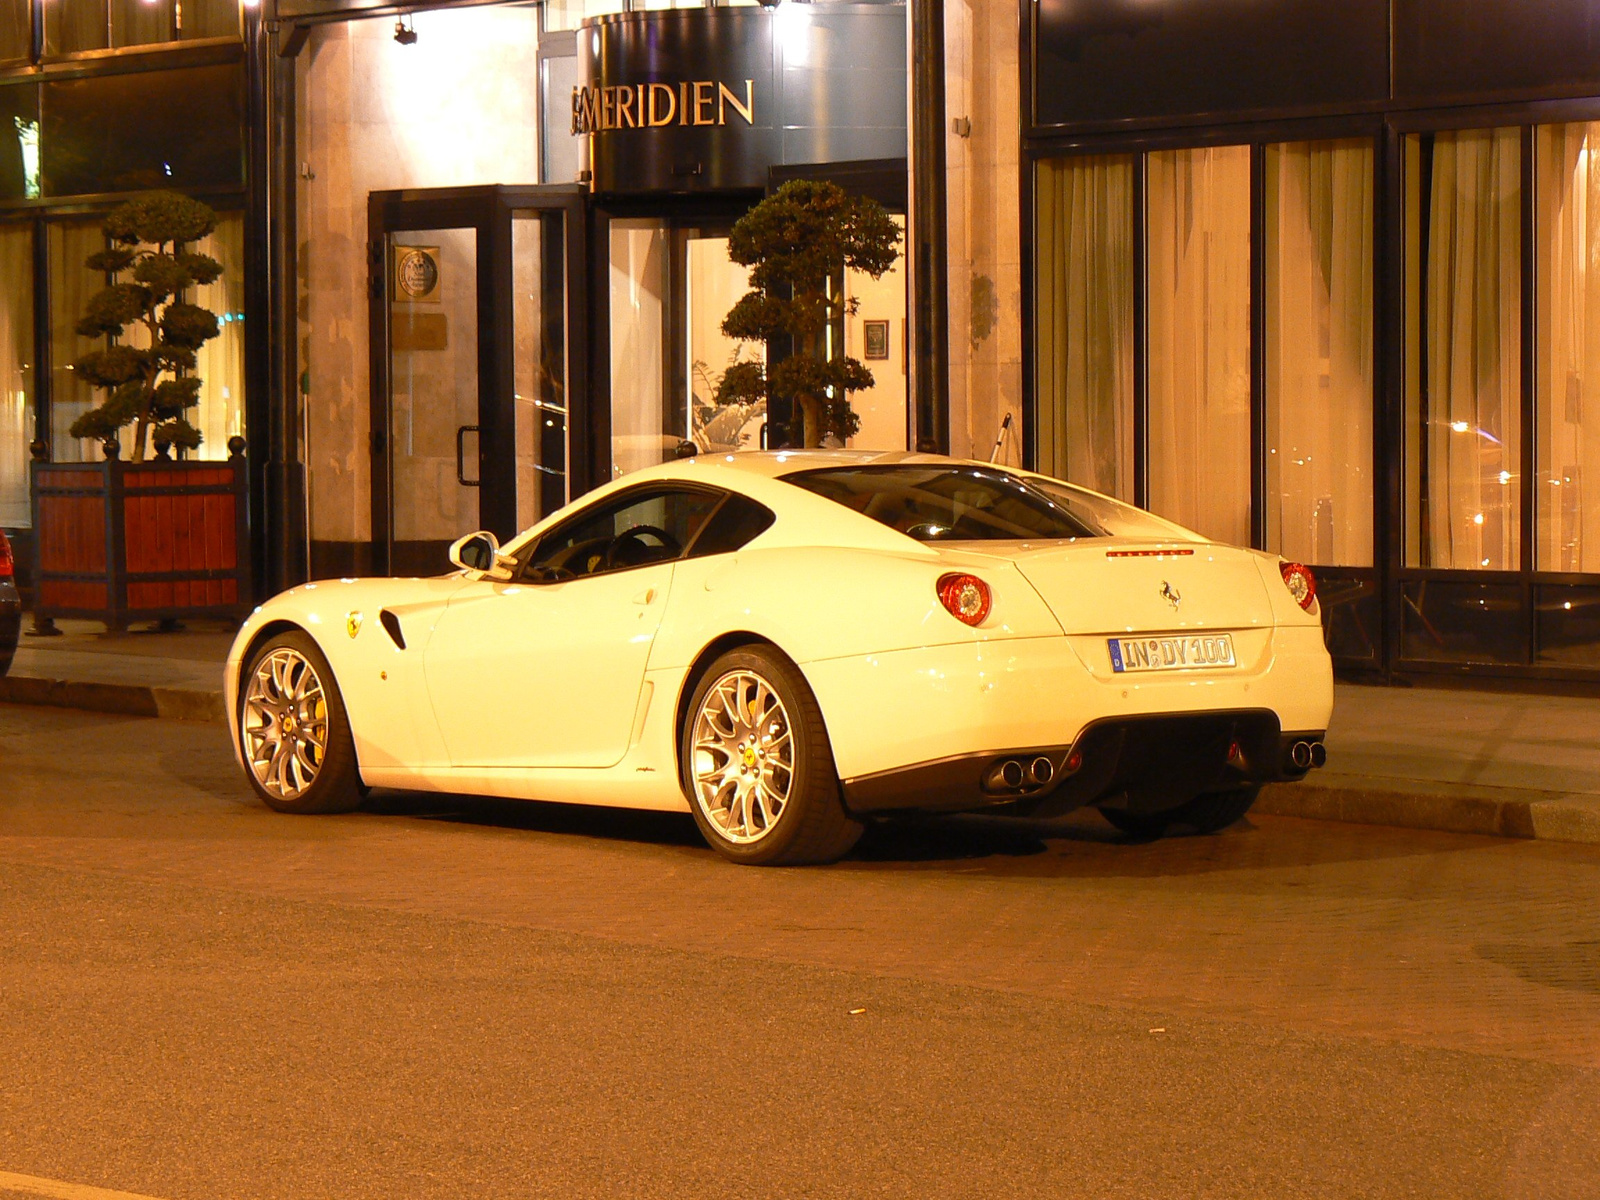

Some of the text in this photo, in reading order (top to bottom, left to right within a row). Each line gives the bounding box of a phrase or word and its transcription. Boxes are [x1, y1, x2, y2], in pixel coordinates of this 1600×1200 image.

[1124, 637, 1231, 667] IN DY 100
